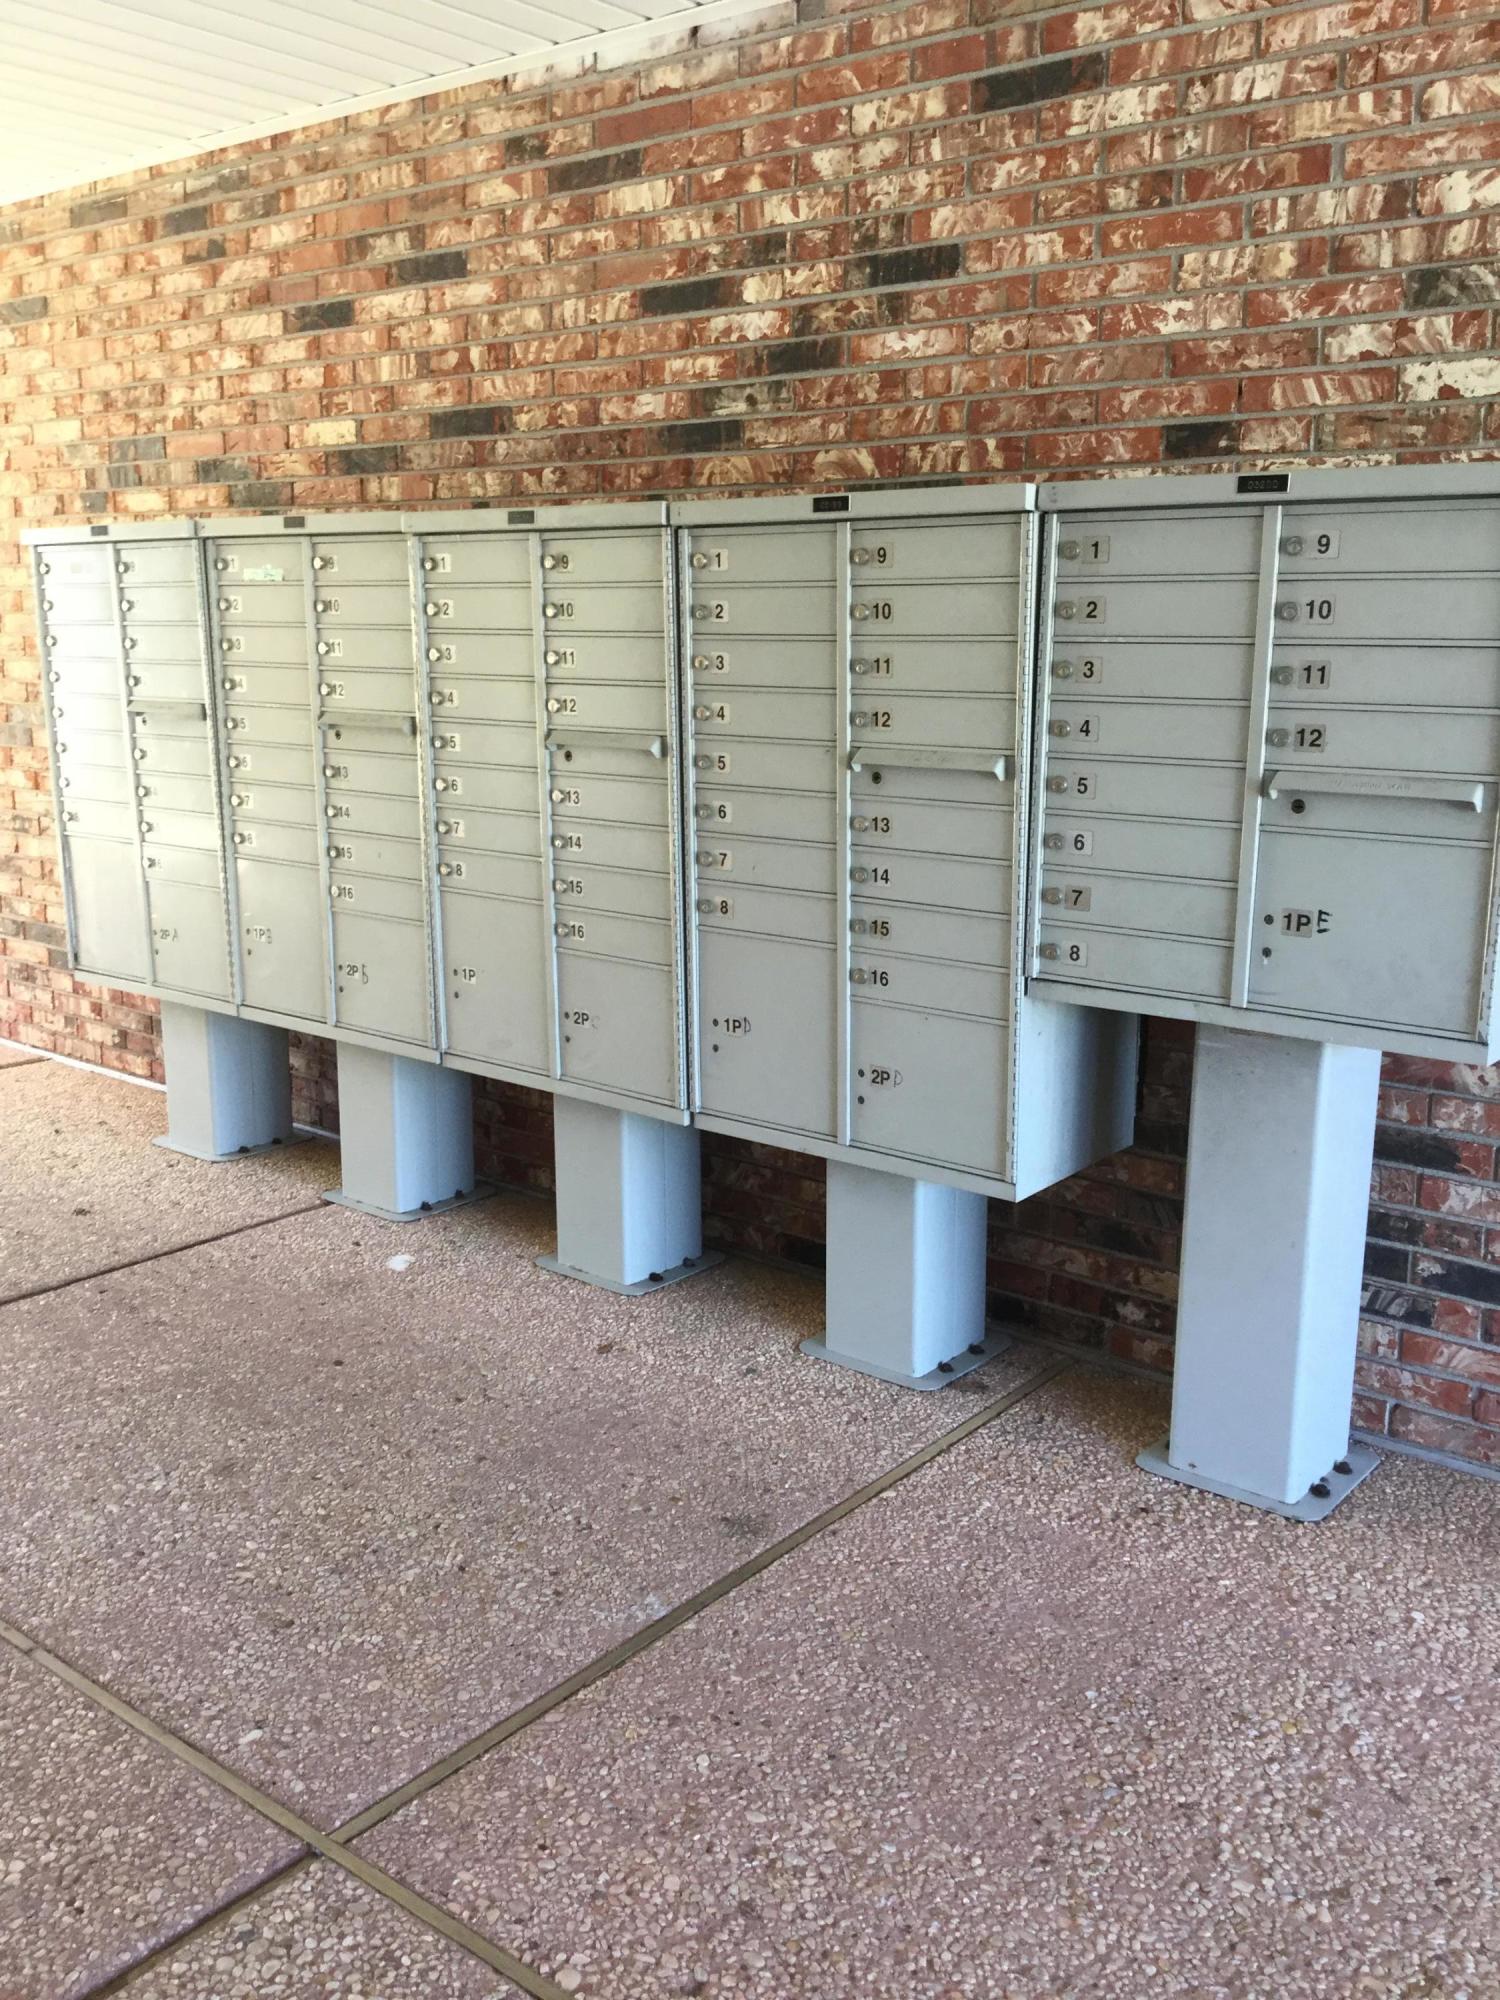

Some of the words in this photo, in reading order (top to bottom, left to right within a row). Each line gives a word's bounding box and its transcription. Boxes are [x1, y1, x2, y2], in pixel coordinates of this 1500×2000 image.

[1091, 540, 1100, 559] 1
[1317, 533, 1331, 555] 9
[561, 554, 569, 570] 9
[714, 552, 721, 568] 1
[876, 546, 887, 564] 9
[441, 556, 446, 571] 1
[232, 598, 239, 611] 2
[442, 602, 450, 617] 2
[559, 602, 574, 617] 10
[715, 603, 724, 620] 2
[872, 602, 892, 620] 10
[1085, 600, 1098, 619] 2
[1305, 599, 1332, 620] 10
[445, 647, 452, 661] 3
[561, 651, 575, 665] 11
[715, 654, 725, 671] 3
[871, 657, 891, 675] 11
[1082, 660, 1095, 679] 3
[1303, 664, 1326, 685] 11
[333, 684, 344, 697] 12
[447, 691, 454, 705] 4
[562, 698, 577, 713] 12
[716, 705, 726, 721] 4
[240, 717, 246, 730] 5
[870, 711, 891, 728] 12
[1079, 719, 1091, 737] 4
[449, 736, 457, 749] 5
[1296, 727, 1323, 748] 12
[717, 755, 726, 771] 5
[451, 779, 459, 792] 6
[1076, 776, 1088, 795] 5
[243, 795, 250, 807] 7
[566, 789, 580, 805] 13
[339, 806, 351, 819] 14
[717, 804, 727, 820] 6
[453, 821, 461, 834] 7
[871, 816, 890, 834] 13
[567, 835, 583, 849] 14
[1073, 833, 1085, 851] 6
[341, 846, 353, 859] 15
[718, 852, 728, 867] 7
[456, 863, 463, 877] 8
[871, 867, 890, 885] 14
[342, 886, 354, 900] 16
[569, 880, 583, 895] 15
[1071, 889, 1083, 906] 7
[719, 899, 729, 915] 8
[869, 919, 890, 937] 15
[1283, 913, 1311, 932] 1P
[570, 924, 585, 939] 16
[1069, 944, 1081, 962] 8
[347, 964, 358, 976] 2P
[462, 968, 476, 981] 1P
[870, 969, 889, 987] 16
[574, 1011, 590, 1025] 2P
[871, 1069, 890, 1085] 2P
